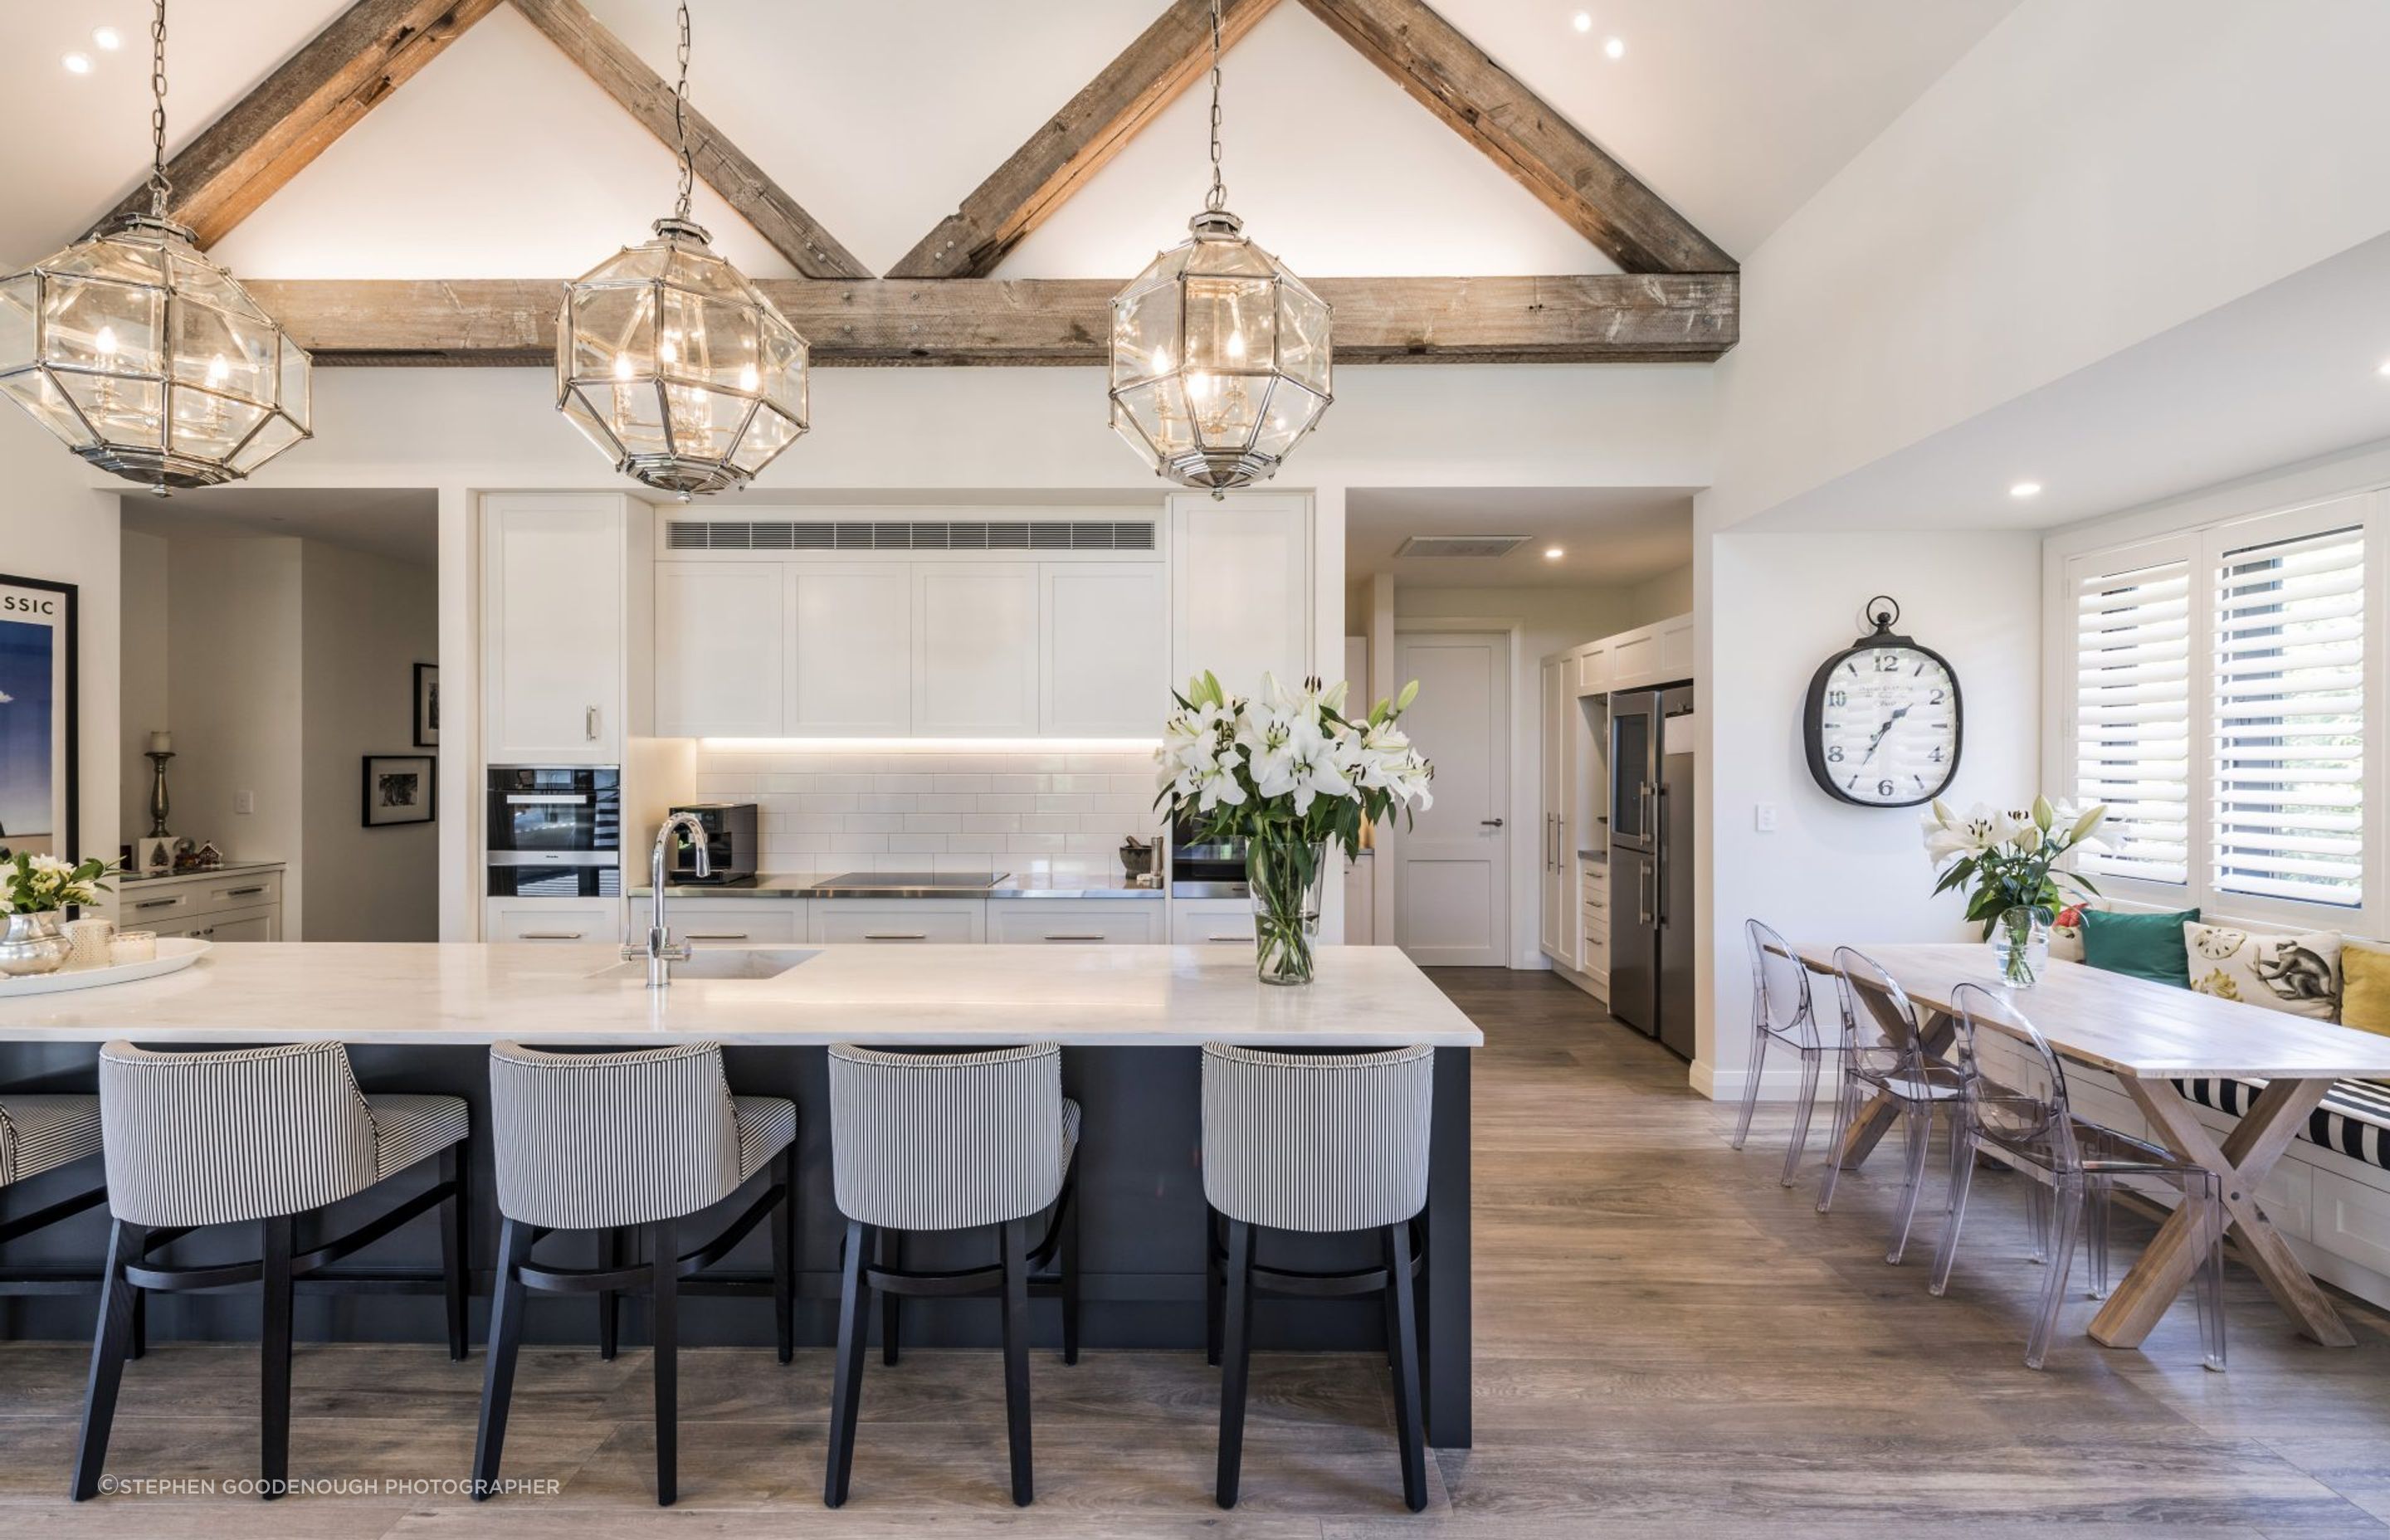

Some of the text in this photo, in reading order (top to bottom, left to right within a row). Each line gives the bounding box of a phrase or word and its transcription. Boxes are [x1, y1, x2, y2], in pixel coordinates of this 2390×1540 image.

[4, 596, 54, 615] SSIC
[1874, 655, 1899, 672] 12
[1827, 690, 1846, 707] 10
[1929, 689, 1944, 705] 2
[1827, 746, 1845, 763] 8
[1927, 746, 1944, 763] 4
[1877, 780, 1894, 797] 6
